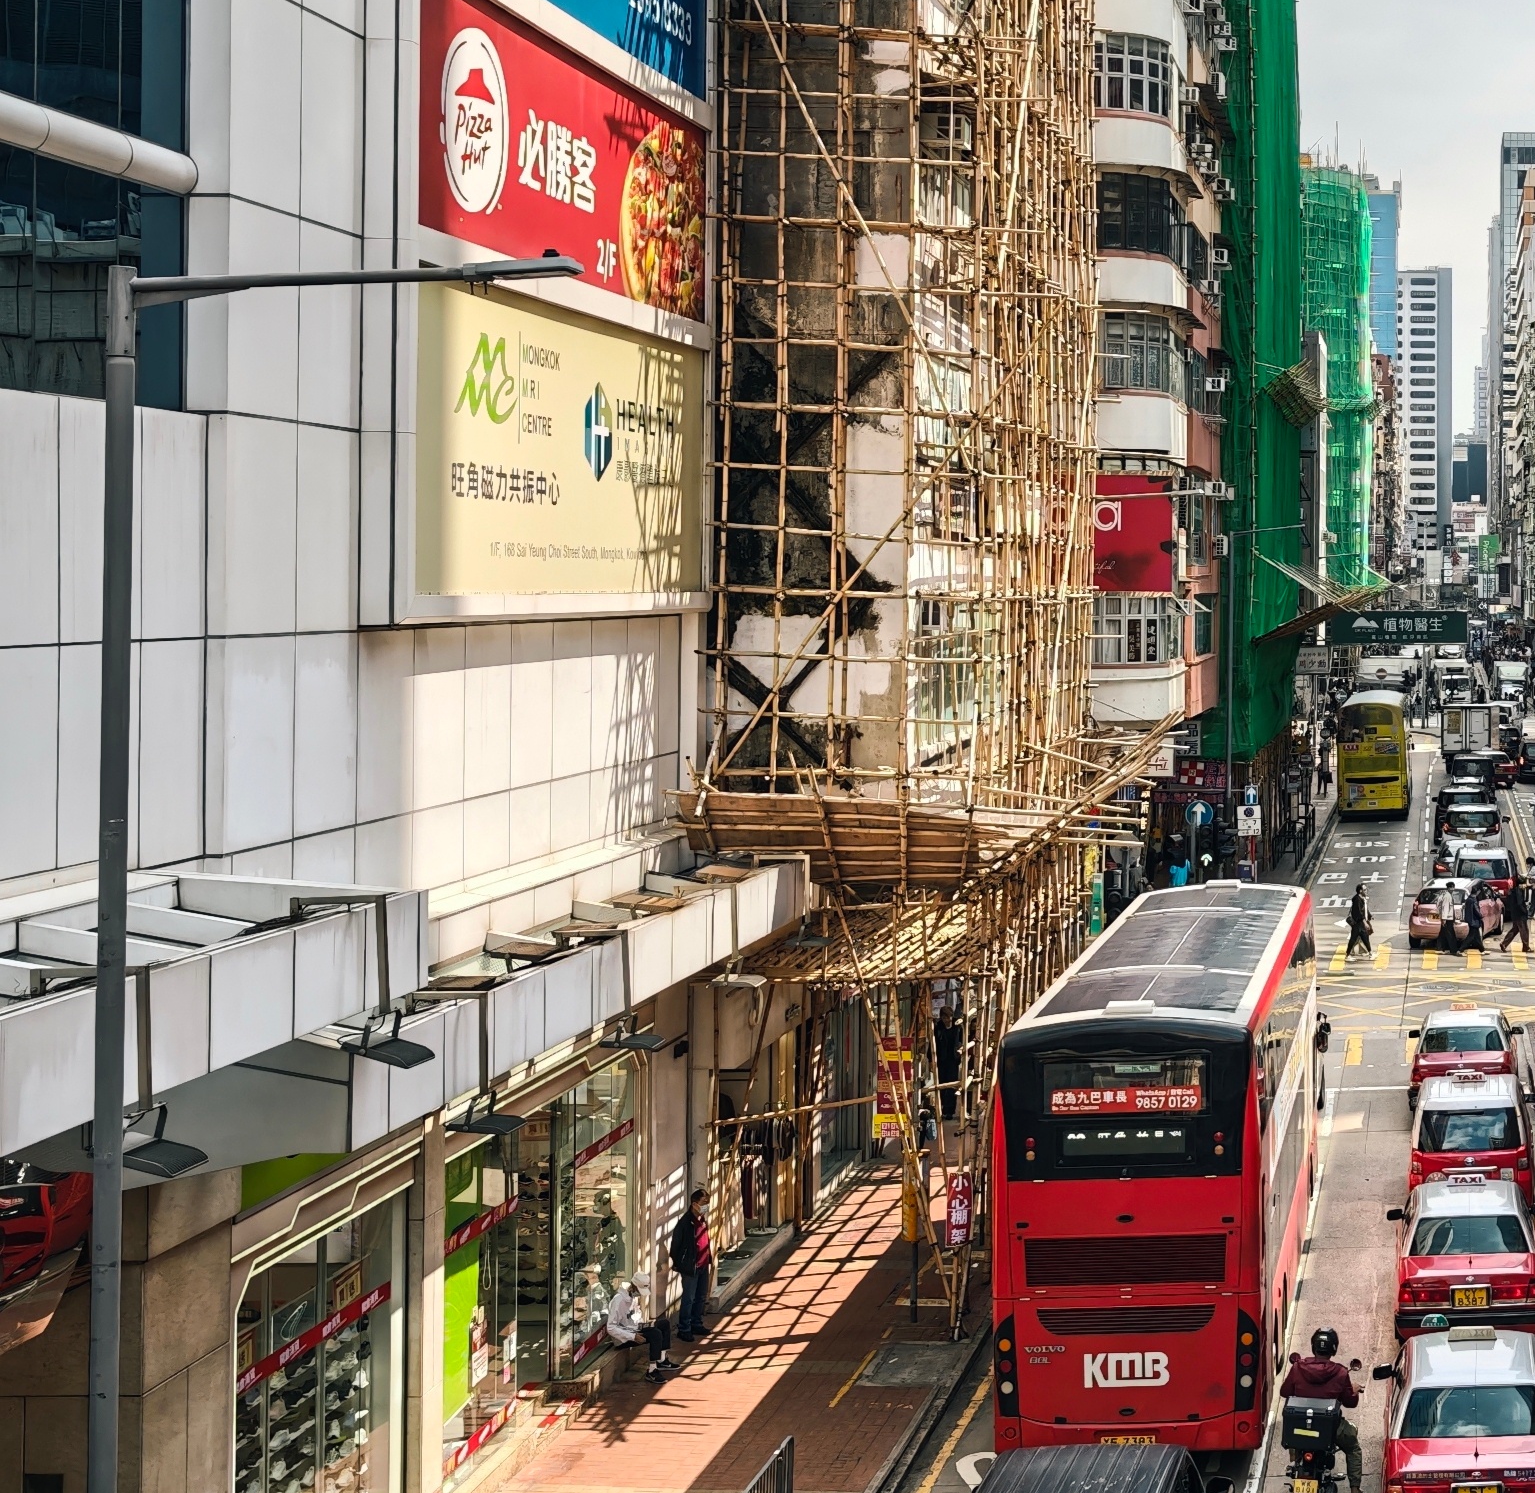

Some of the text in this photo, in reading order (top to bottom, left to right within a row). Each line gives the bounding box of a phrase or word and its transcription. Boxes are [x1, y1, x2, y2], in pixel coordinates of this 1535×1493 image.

[454, 101, 494, 146] Pizza
[460, 140, 492, 175] Hut
[518, 108, 598, 213] 必勝客
[596, 238, 617, 284] 2/F
[522, 343, 561, 372] MONGKOK
[521, 412, 552, 437] CENTRE
[616, 398, 674, 440] HEALTH
[451, 461, 561, 506] 旺角磁力共振中心
[1383, 617, 1444, 632] 植物醫生
[1322, 855, 1397, 864] STOP
[1316, 871, 1390, 885] 巴士
[1052, 1090, 1128, 1105] 成為九巴車長
[1135, 1095, 1198, 1109] 9857 0129
[1452, 1176, 1482, 1184] TAXI
[950, 1175, 969, 1244] 小心棚架
[1457, 1296, 1485, 1306] 8387
[1023, 1345, 1066, 1354] VOLVO
[1083, 1351, 1170, 1389] KMB
